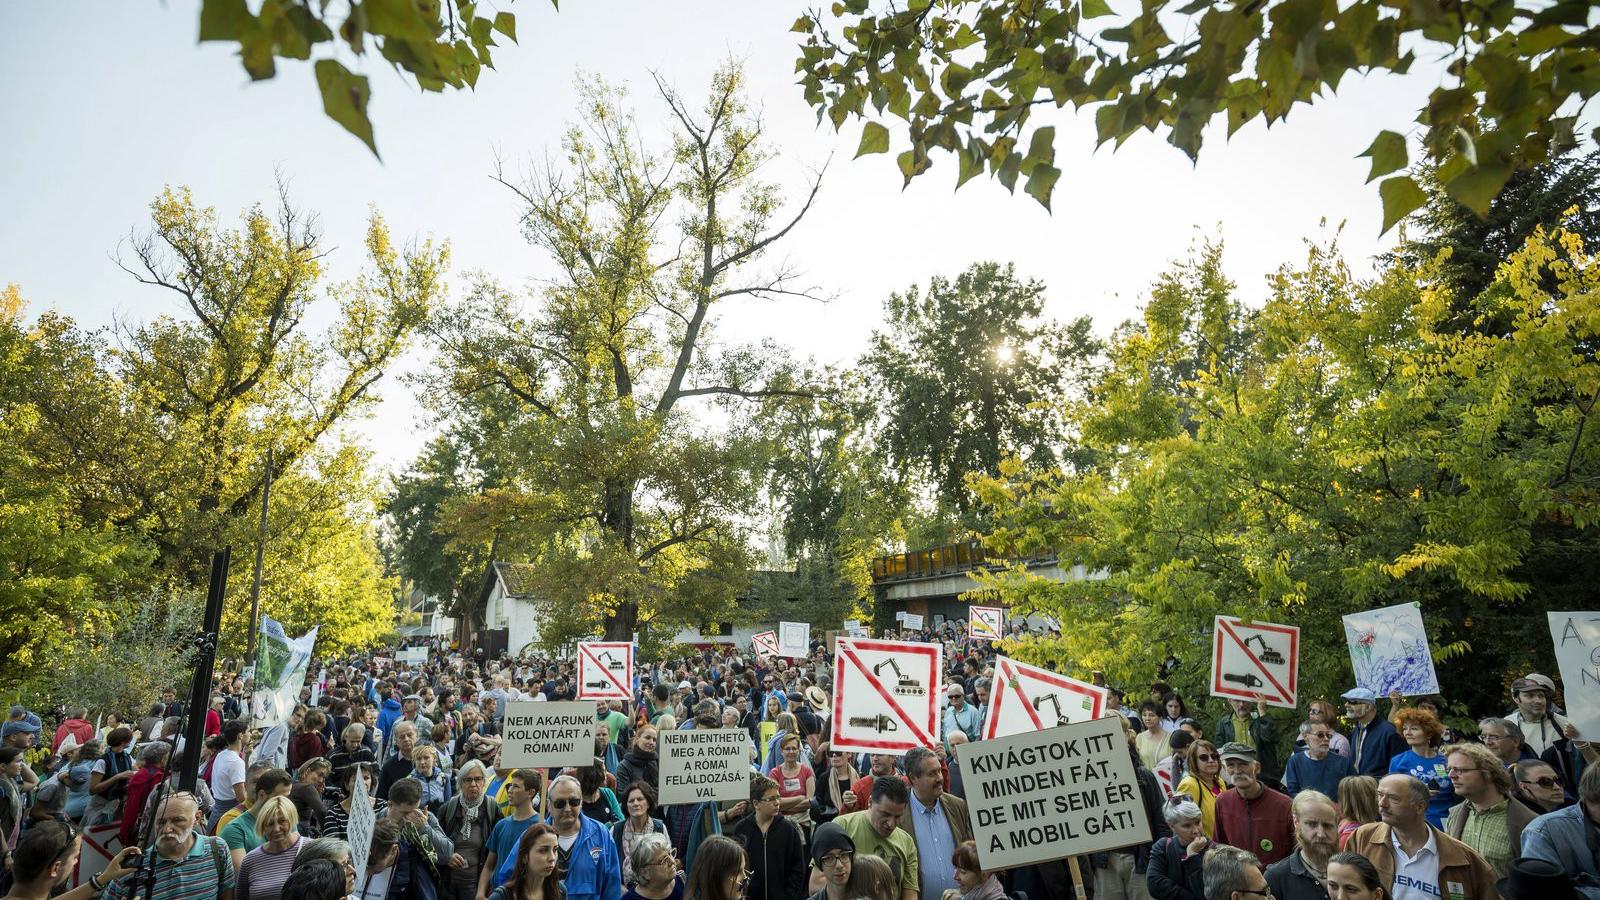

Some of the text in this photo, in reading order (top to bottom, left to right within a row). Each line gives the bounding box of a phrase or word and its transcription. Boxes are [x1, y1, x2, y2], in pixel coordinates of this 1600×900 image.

[507, 716, 594, 726] NEM AKARUNK
[507, 727, 591, 740] KOLONTÁRT A
[664, 731, 746, 745] NEM MENTHETŐ
[523, 741, 574, 753] RÓMAIN!
[671, 745, 740, 757] MEG A RÓMAI
[969, 732, 1115, 774] KIVÁGTOK ITT
[683, 758, 728, 771] A RÓMAI
[665, 770, 745, 785] FELÁLDOZÁSÁ-
[982, 758, 1118, 799] MINDEN FÁT,
[695, 787, 717, 798] VAL
[976, 781, 1136, 828] DE MIT SEM ÉR
[989, 809, 1136, 853] A MOBIL GÁT!
